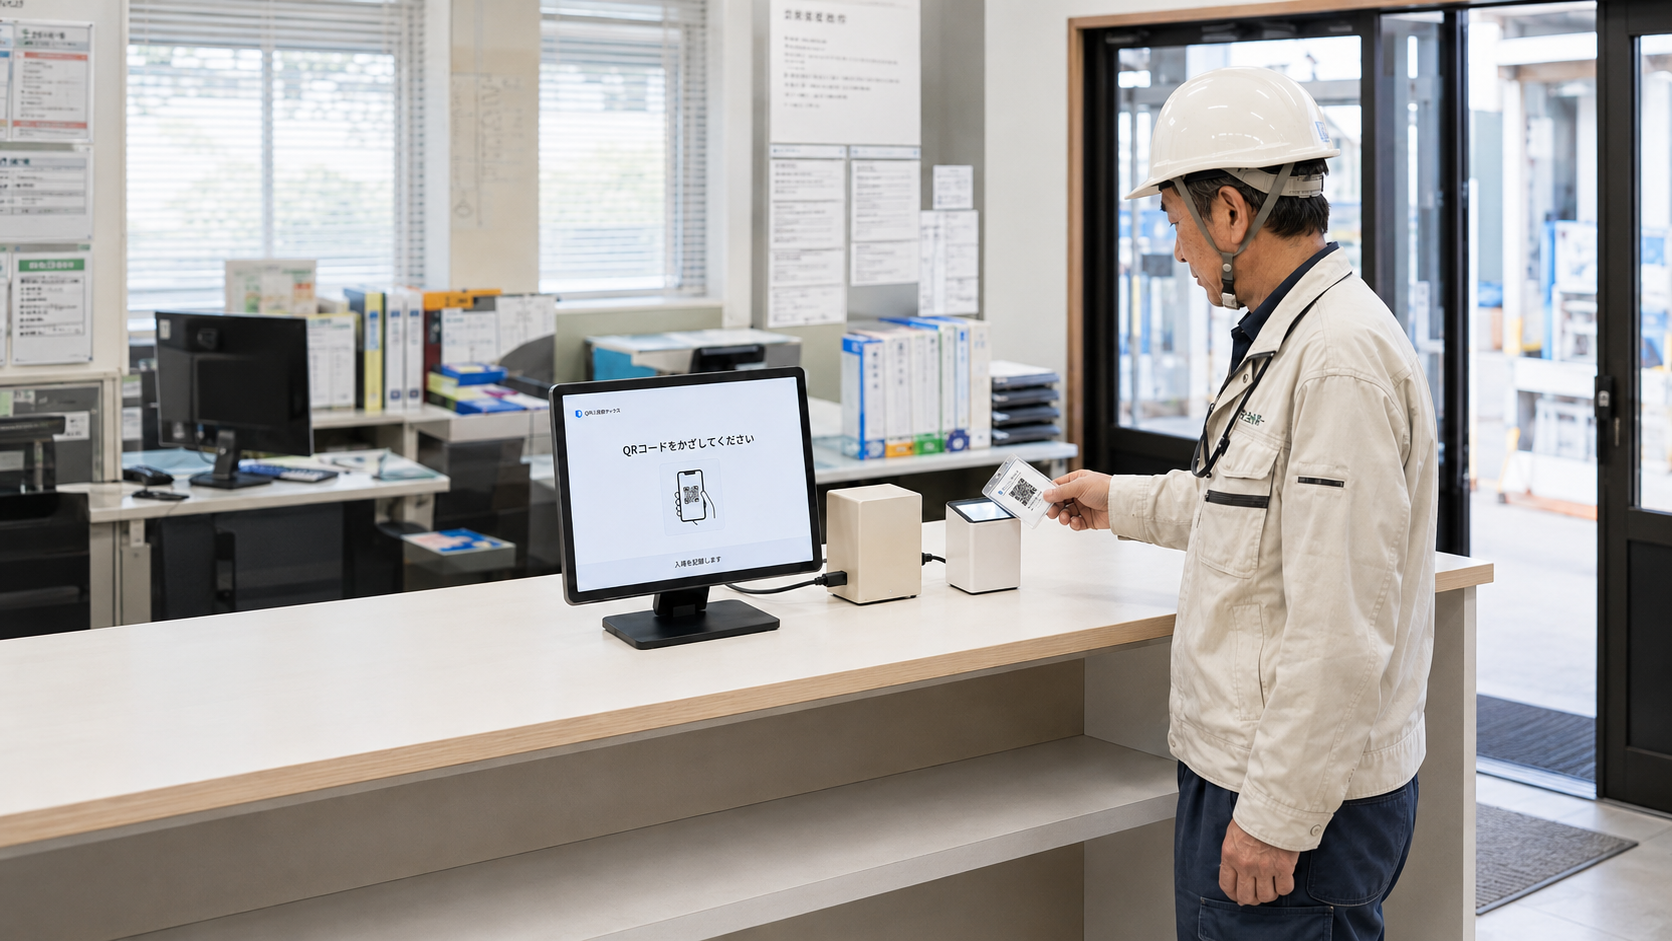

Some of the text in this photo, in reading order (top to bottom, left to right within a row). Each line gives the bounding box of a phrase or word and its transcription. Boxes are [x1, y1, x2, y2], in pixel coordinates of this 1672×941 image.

[622, 434, 755, 457] QRコードをかざしてください
